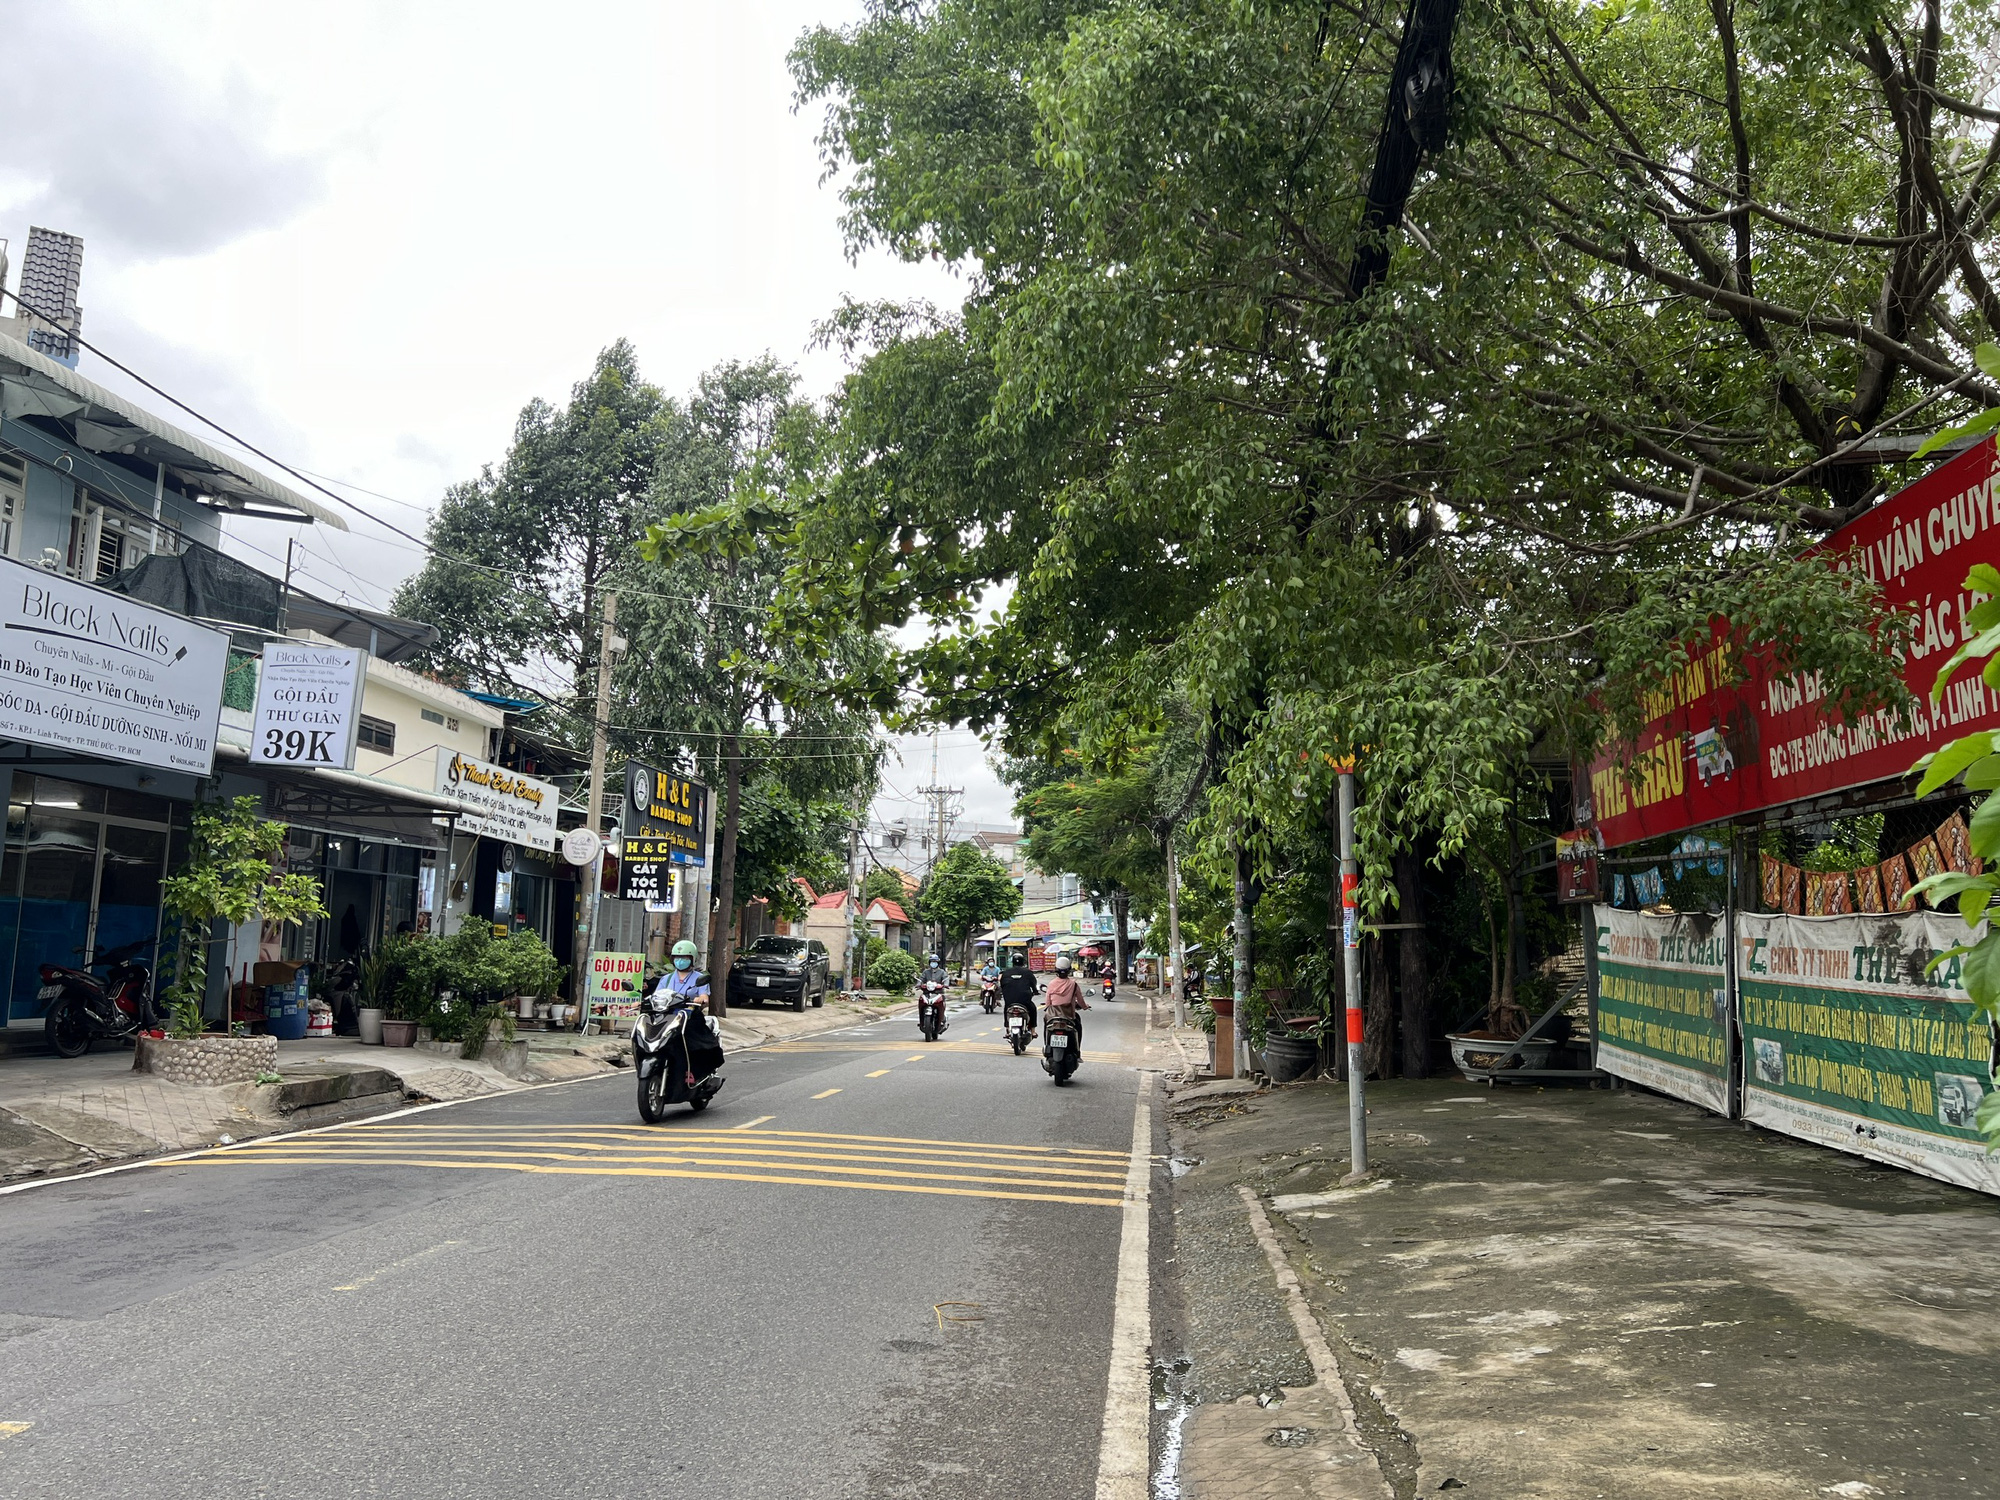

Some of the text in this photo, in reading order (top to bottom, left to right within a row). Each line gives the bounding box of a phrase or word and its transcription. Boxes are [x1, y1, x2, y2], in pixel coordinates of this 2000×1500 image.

[1876, 516, 1924, 588] VẬN
[22, 584, 170, 656] Black Nails
[1908, 592, 1955, 660] CÁC
[34, 639, 155, 683] Chuyên Nails Mi Gội Đầu
[275, 651, 342, 666] Black Nails
[15, 658, 40, 679] Đào
[44, 666, 67, 687] Tạo
[70, 673, 94, 693] Học
[97, 680, 121, 699] Viên
[124, 687, 164, 710] Chuyên
[166, 698, 201, 721] Nghiệp
[273, 686, 339, 705] GỘI ĐẦU
[1767, 671, 1803, 718] MUA
[25, 698, 42, 716] DA
[51, 703, 74, 724] GỘI
[75, 706, 100, 728] ĐẦU
[101, 716, 141, 737] DƯỠNG
[142, 725, 168, 743] SINH
[174, 730, 194, 749] NỐI
[194, 739, 207, 752] MI
[265, 708, 342, 725] THƯ GIÃN
[1804, 719, 1847, 769] ĐƯỜNG
[1846, 714, 1878, 756] LINH
[1945, 674, 1987, 725] LINH
[37, 728, 52, 738] Linh
[53, 732, 72, 743] Trung
[100, 741, 115, 751] ĐỨC
[127, 746, 142, 757] HCM
[262, 728, 336, 763] 39K
[656, 772, 668, 801] H
[669, 779, 680, 806] &
[681, 782, 690, 809] C
[650, 803, 693, 828] BARBER SHOP
[626, 841, 668, 854] H & C
[685, 836, 698, 850] Nam
[630, 875, 658, 888] TÓC
[632, 861, 659, 875] CẮT
[626, 888, 660, 899] NAM
[594, 956, 615, 976] GỘI
[1817, 948, 1849, 979] TNHH
[1911, 1005, 1931, 1055] TẤT
[1785, 1052, 1796, 1084] XE
